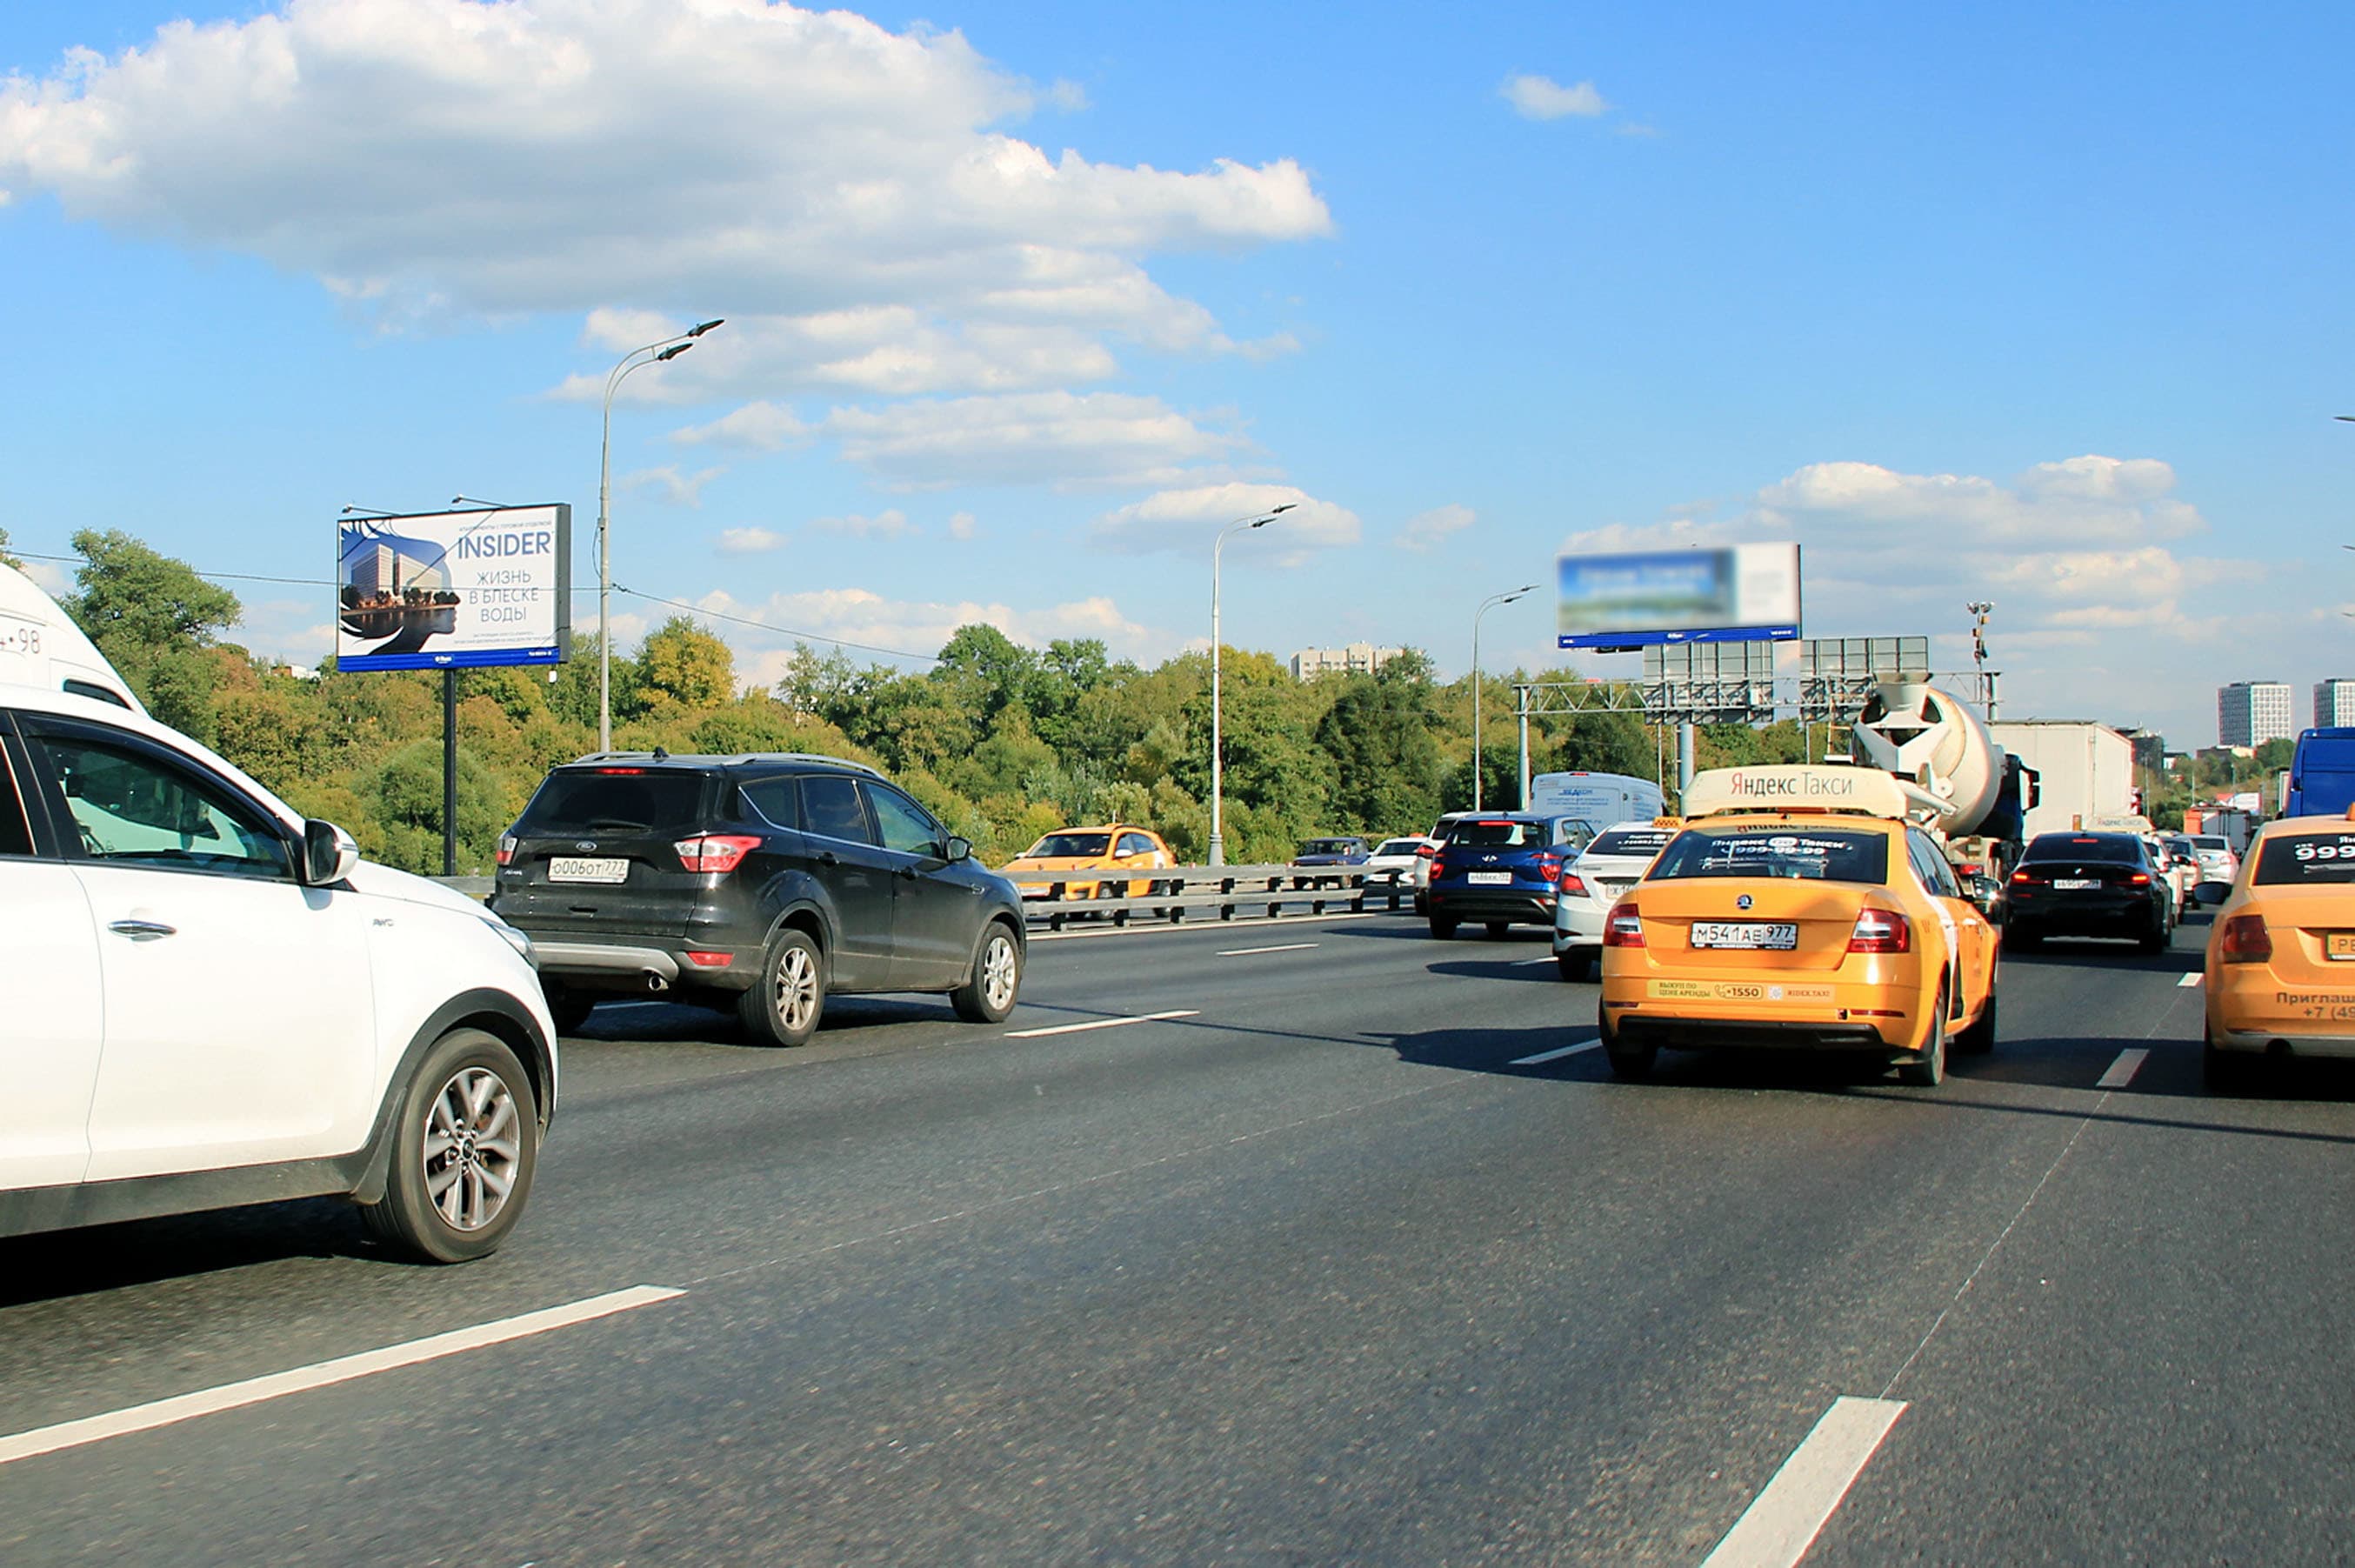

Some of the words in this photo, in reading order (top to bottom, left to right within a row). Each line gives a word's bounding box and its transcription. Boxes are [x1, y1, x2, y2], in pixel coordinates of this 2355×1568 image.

[458, 531, 551, 559] INSIDER
[477, 570, 532, 585] ЖИЗНЬ
[469, 590, 478, 604] В
[483, 588, 538, 604] БЛЕСКЕ
[481, 607, 527, 622] ВОДЫ
[1731, 772, 1798, 797] Яндекс
[1802, 771, 1852, 795] Такси
[2295, 845, 2355, 861] 999
[1766, 925, 1792, 938] 977
[2304, 1006, 2324, 1018] +7
